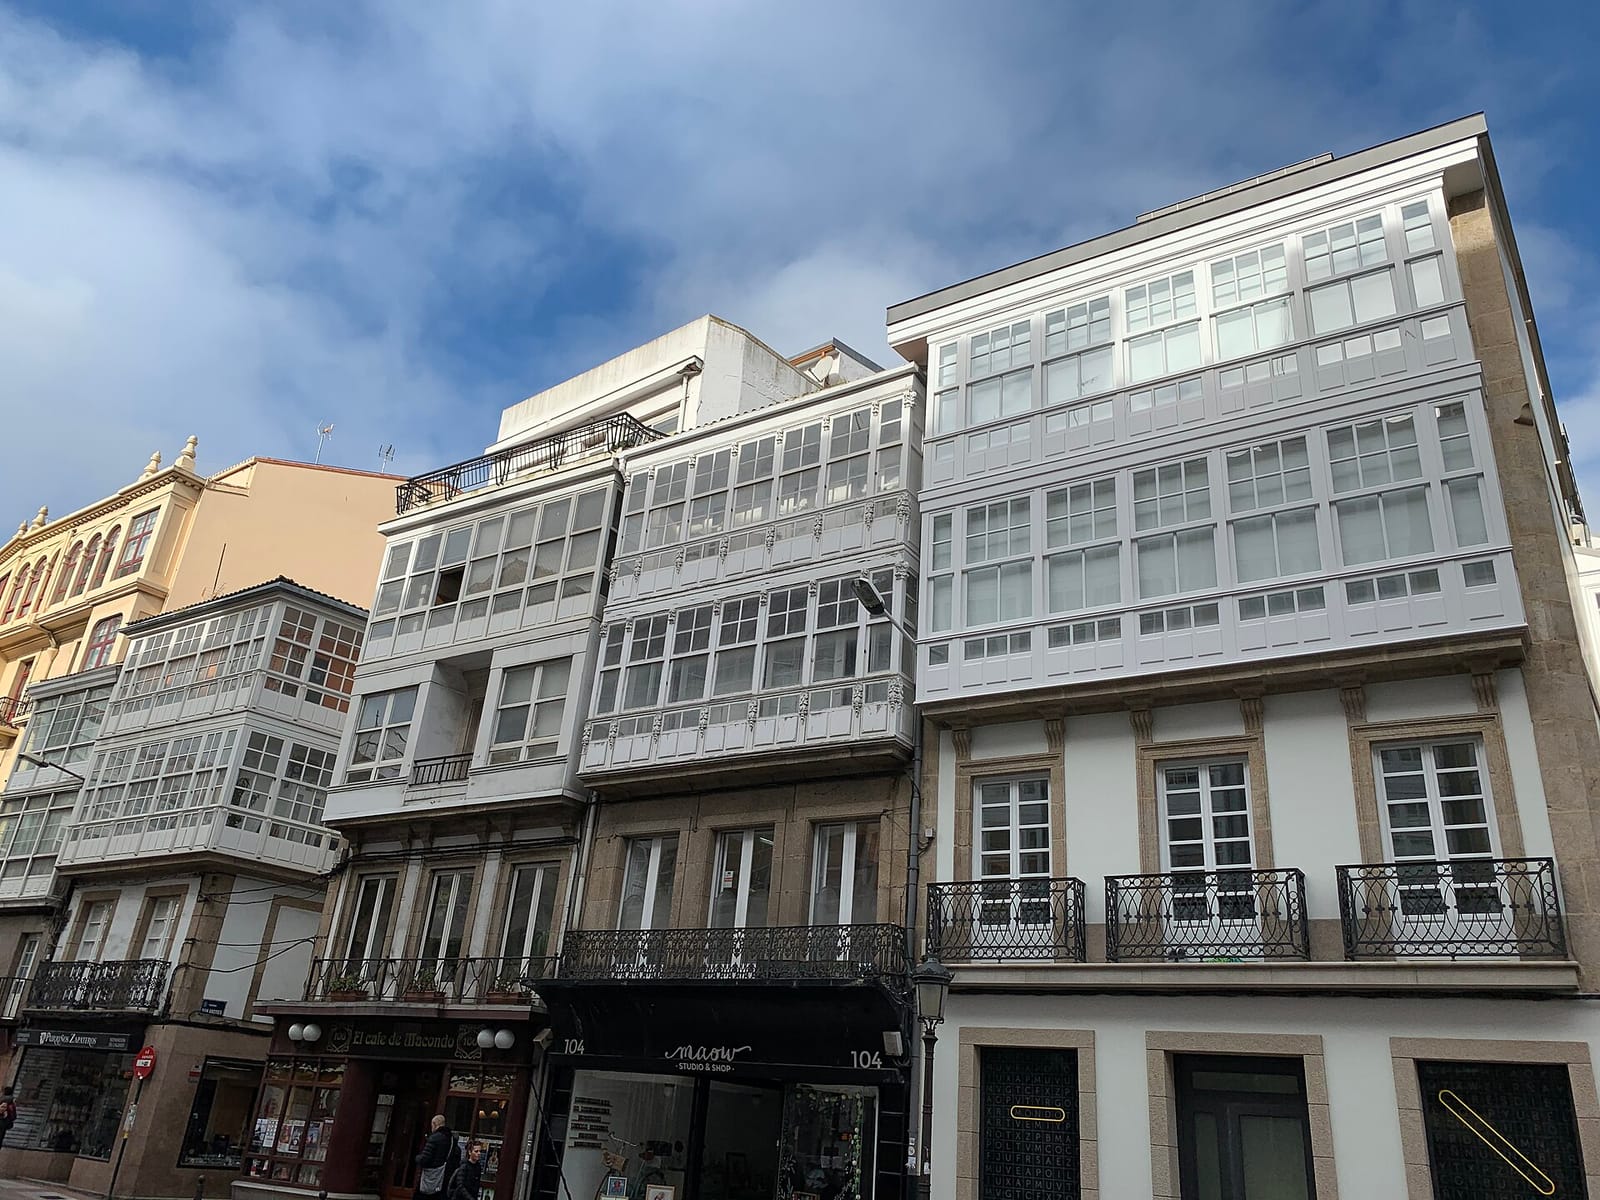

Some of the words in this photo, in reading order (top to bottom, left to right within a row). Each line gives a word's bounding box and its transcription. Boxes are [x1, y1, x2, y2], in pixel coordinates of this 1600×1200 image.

[353, 1031, 364, 1045] El
[388, 1032, 401, 1046] de
[403, 1032, 455, 1048] Macondo
[564, 1039, 585, 1055] 104
[664, 1044, 752, 1062] maow
[850, 1050, 883, 1069] 104
[679, 1062, 705, 1071] STUDIO
[705, 1063, 711, 1071] &
[711, 1063, 732, 1073] SHOP
